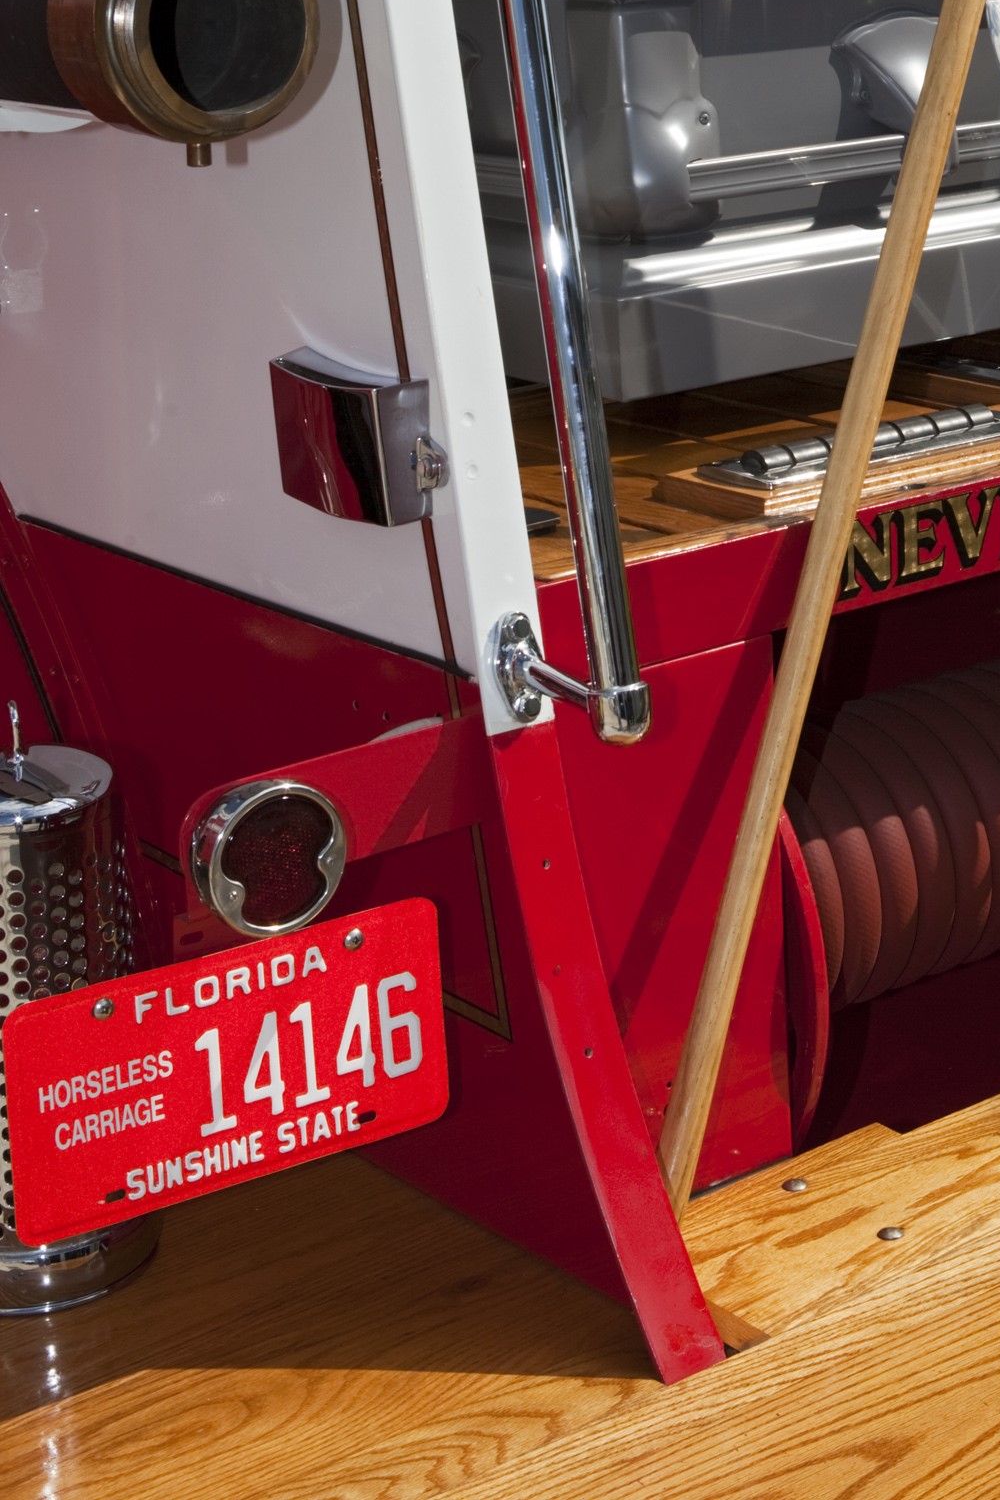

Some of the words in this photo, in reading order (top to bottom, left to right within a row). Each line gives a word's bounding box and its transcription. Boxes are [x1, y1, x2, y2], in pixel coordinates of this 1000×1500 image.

[134, 946, 327, 1024] FLORIDA
[38, 1050, 174, 1113] HORSELESS
[194, 971, 423, 1137] 14146
[54, 1094, 165, 1151] CARRIAGE
[126, 1131, 265, 1200] SUNSHINE
[278, 1101, 361, 1154] STATE
